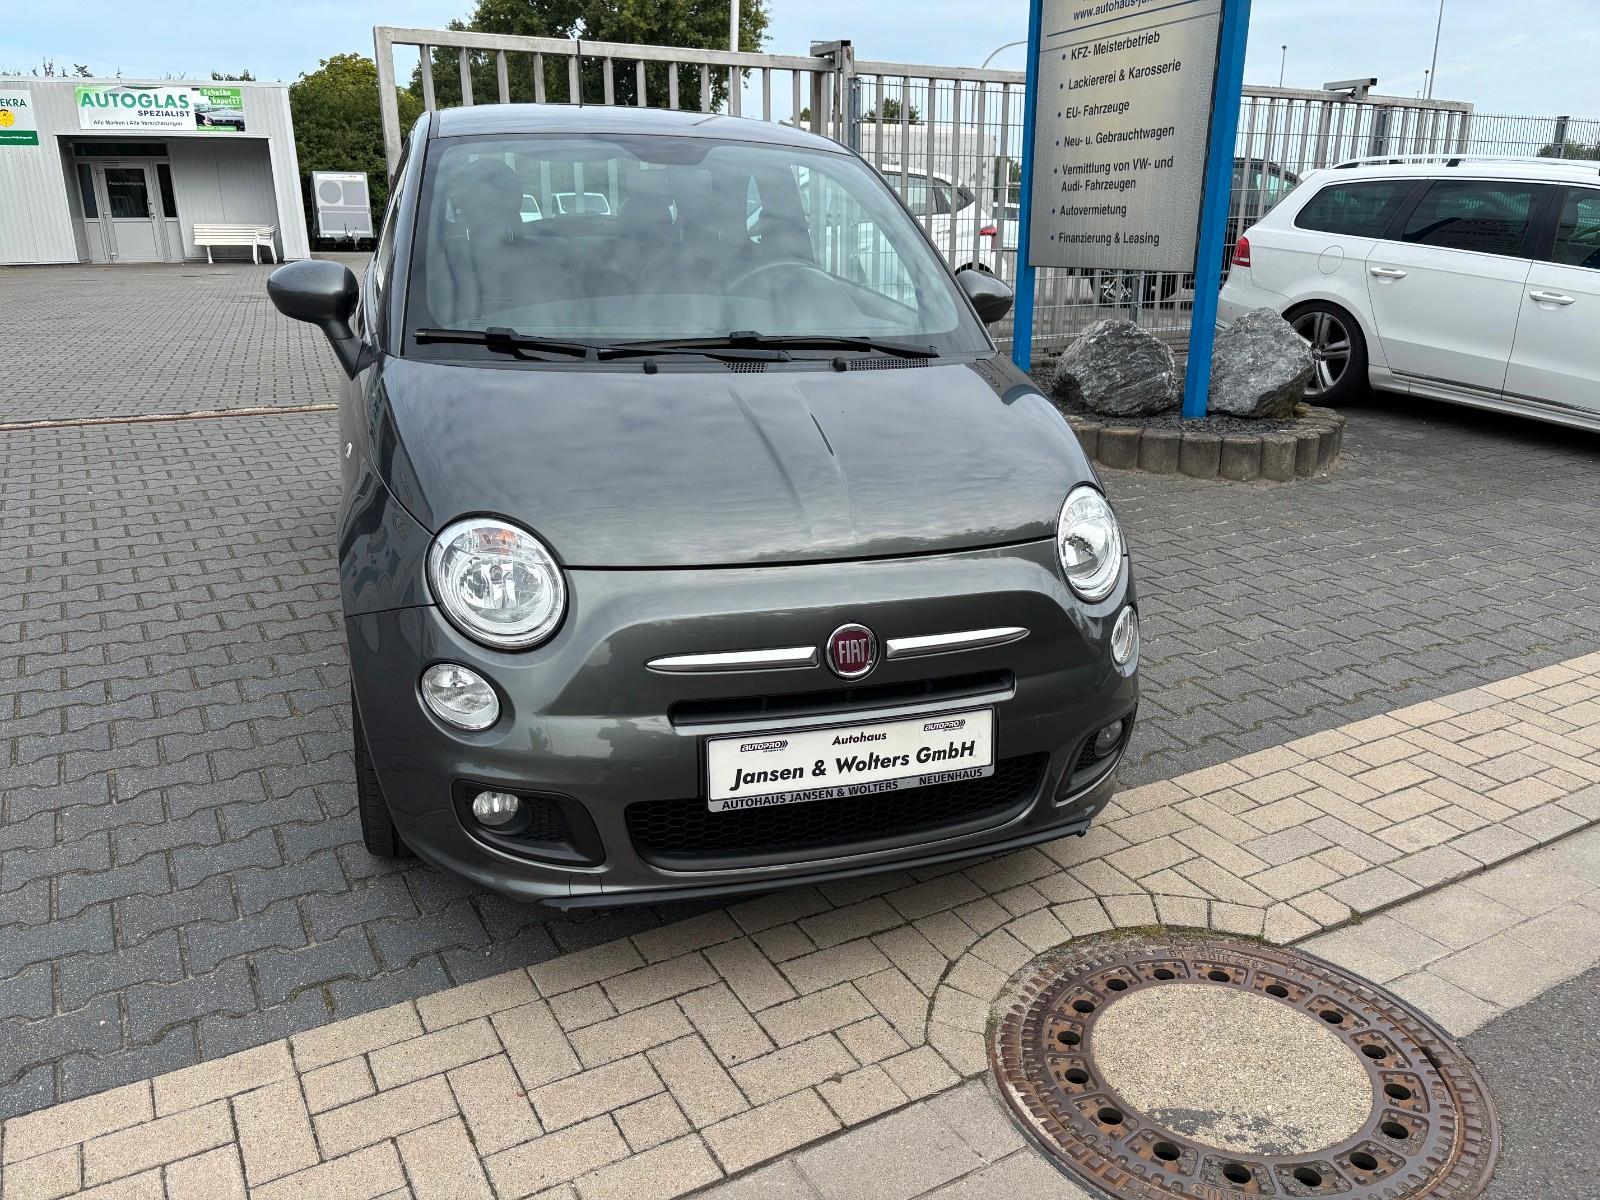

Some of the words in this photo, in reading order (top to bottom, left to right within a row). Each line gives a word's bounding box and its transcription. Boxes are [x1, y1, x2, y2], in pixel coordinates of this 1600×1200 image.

[1071, 46, 1091, 61] KFZ-
[1093, 31, 1160, 57] Meisterbetrieb
[1068, 70, 1117, 90] Lackiererei
[1119, 69, 1125, 81] &
[1128, 59, 1182, 80] Karosserie
[0, 98, 27, 107] EKRA
[81, 93, 190, 109] AUTOGLAS
[1066, 107, 1081, 119] EU-
[1083, 101, 1130, 117] Fahrzeuge
[1064, 136, 1083, 147] Neu-
[1085, 136, 1093, 145] u.
[1095, 126, 1175, 144] Gebrauchtwagen
[1062, 162, 1111, 175] Vermittlung
[1113, 161, 1130, 172] von
[1132, 158, 1152, 169] VW-
[1154, 156, 1174, 168] und
[1061, 181, 1083, 192] Audi-
[1085, 179, 1136, 192] Fahrzeugen
[1060, 204, 1127, 217] Autovermietung
[1058, 232, 1112, 246] Finanzierung
[1114, 232, 1121, 244] &
[1123, 232, 1160, 247] Leasing
[838, 638, 868, 664] FIAT
[832, 731, 887, 745] Autohaus
[729, 766, 804, 791] Jansen
[811, 759, 826, 776] &
[835, 751, 910, 775] Wolters
[915, 740, 976, 764] GmbH
[722, 794, 786, 810] AUTOHAUS
[789, 788, 834, 802] JANSEN
[836, 787, 845, 797] &
[849, 780, 898, 796] WOLTERS
[919, 768, 983, 785] NEUENHAUS
